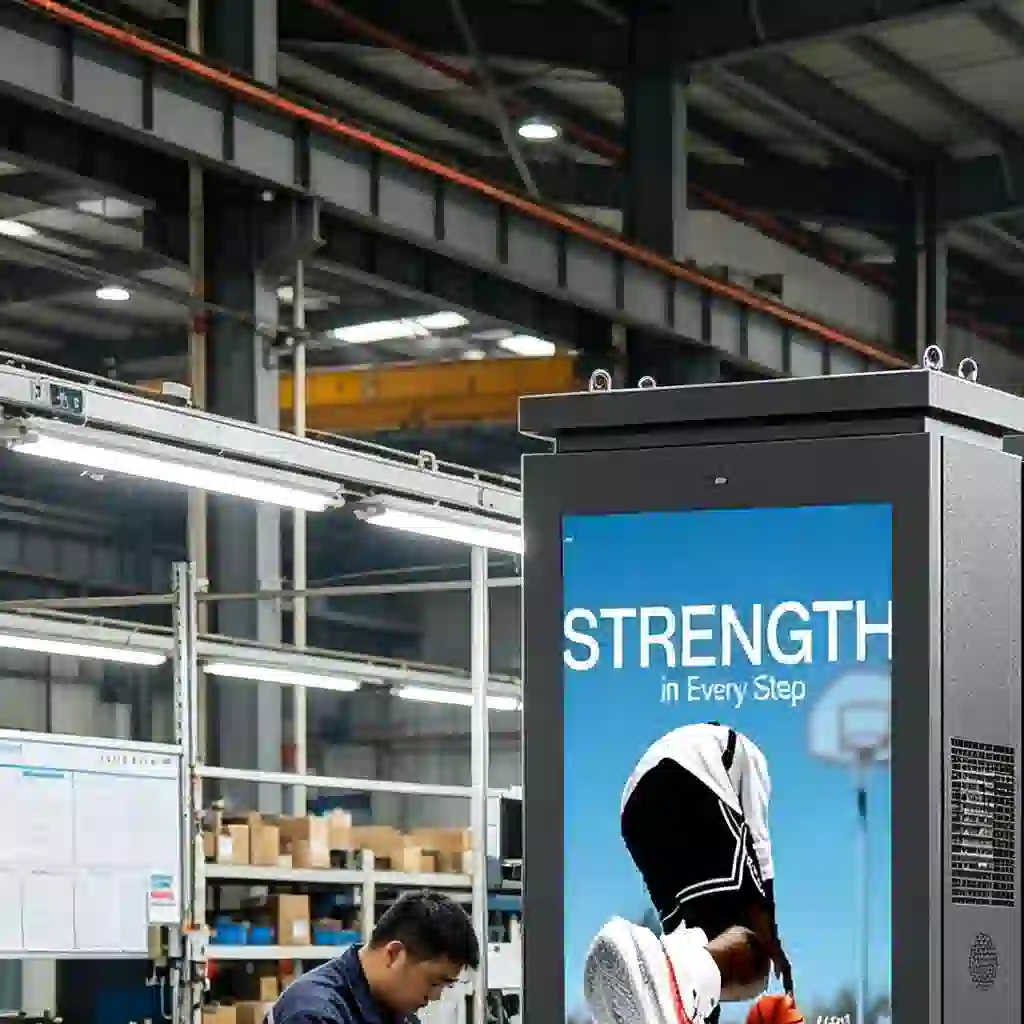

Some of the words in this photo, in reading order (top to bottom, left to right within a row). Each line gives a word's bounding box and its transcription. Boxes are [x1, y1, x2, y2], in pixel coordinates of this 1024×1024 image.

[563, 600, 893, 671] STRENGTH
[660, 675, 679, 702] in
[687, 675, 748, 709] Every
[753, 674, 807, 706] Step
